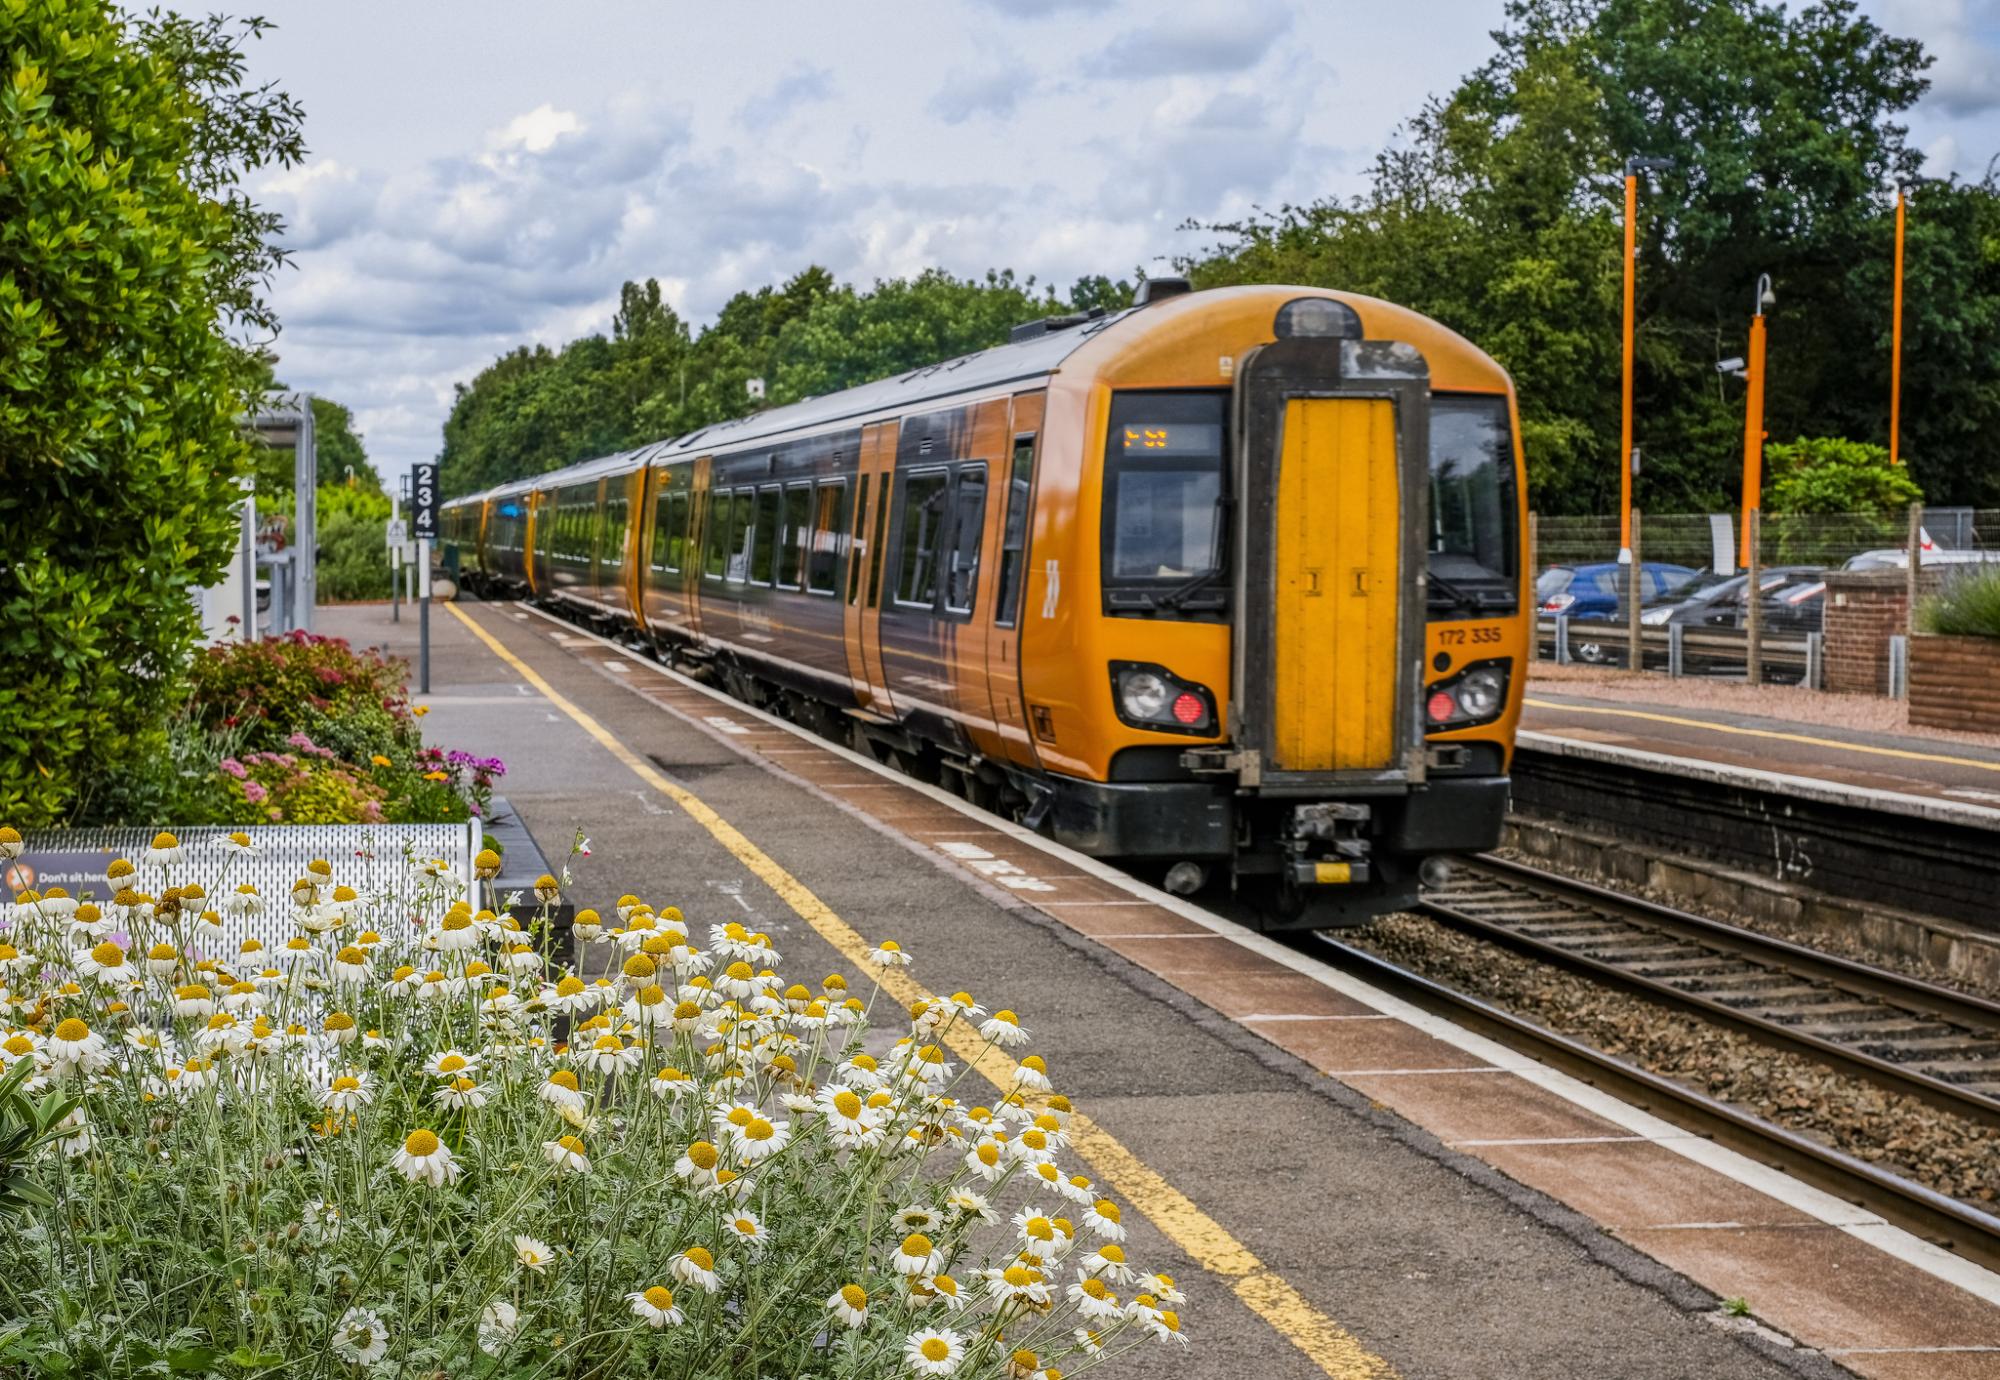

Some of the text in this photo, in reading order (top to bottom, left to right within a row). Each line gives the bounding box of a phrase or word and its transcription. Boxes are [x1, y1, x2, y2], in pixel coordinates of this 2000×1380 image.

[418, 466, 432, 485] 2
[418, 487, 433, 507] 3
[417, 509, 432, 528] 4
[1438, 627, 1502, 645] 172 335
[39, 872, 67, 883] Don't
[69, 871, 82, 882] sit
